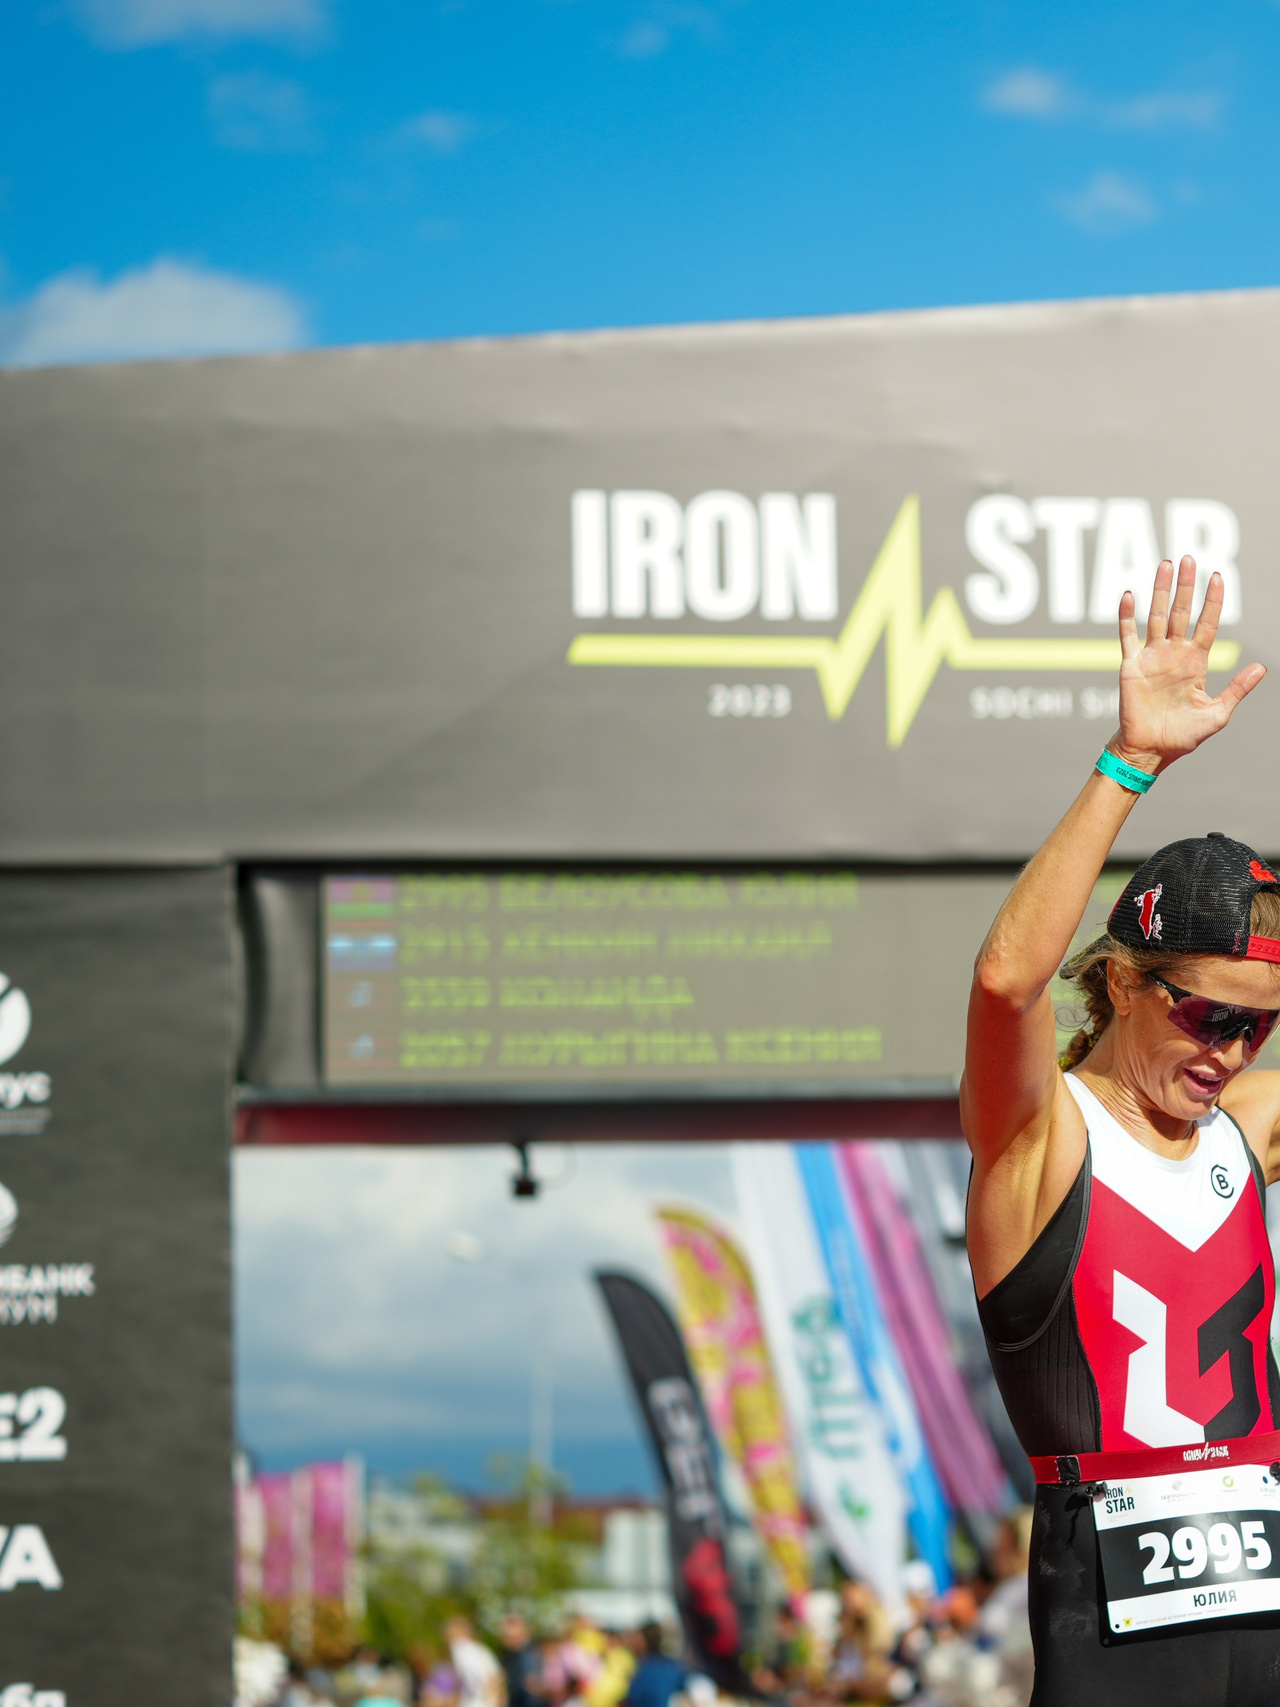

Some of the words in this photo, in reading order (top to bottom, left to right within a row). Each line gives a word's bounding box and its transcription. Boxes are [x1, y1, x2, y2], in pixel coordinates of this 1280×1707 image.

[571, 489, 838, 621] IRON
[965, 494, 1242, 624] STAR
[708, 684, 792, 718] 2023
[969, 686, 1072, 720] SOCHI
[1105, 1496, 1135, 1514] STAR
[1138, 1520, 1272, 1586] 2995
[1193, 1589, 1237, 1608] ЮЛИЯ
